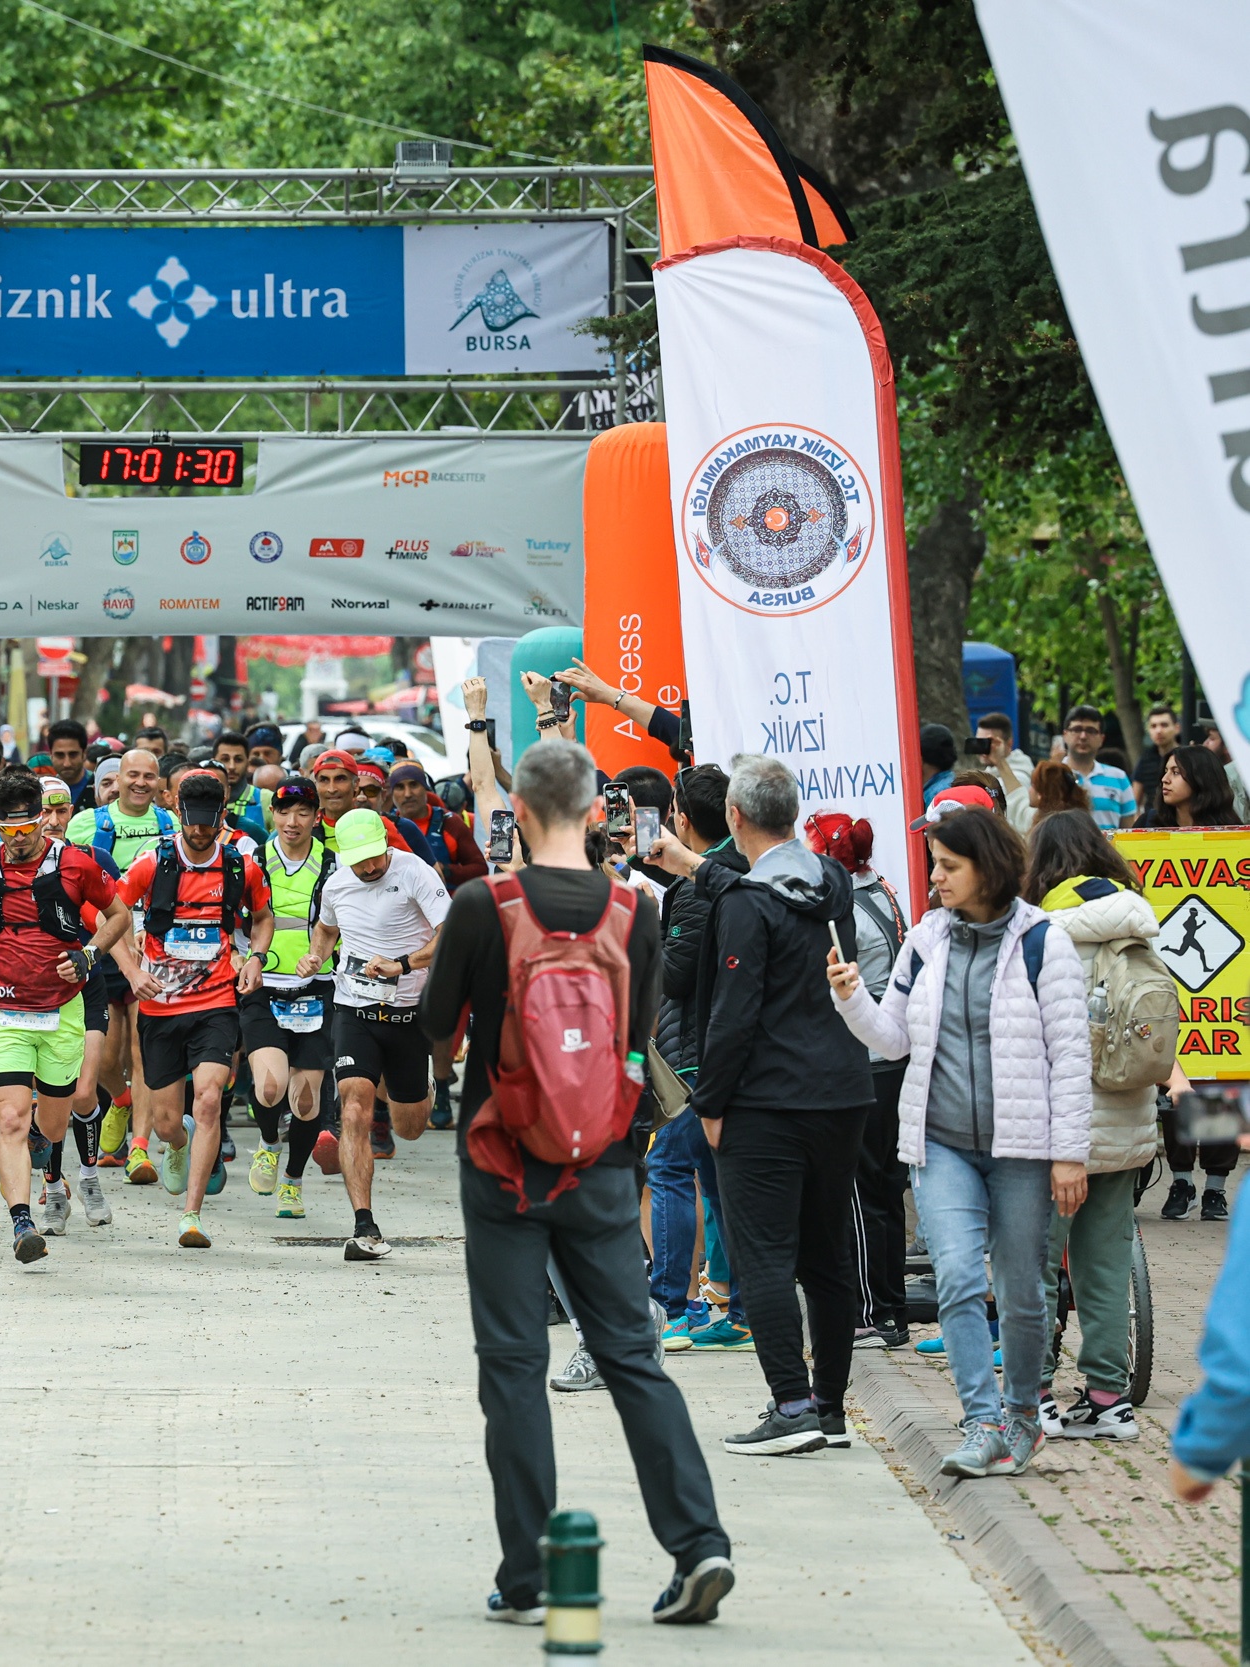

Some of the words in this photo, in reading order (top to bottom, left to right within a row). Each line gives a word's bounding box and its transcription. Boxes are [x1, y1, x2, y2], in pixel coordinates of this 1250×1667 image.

[231, 273, 349, 319] ultra
[466, 334, 531, 352] BURSA
[100, 447, 237, 485] 17:01:30
[382, 469, 429, 488] MCR
[394, 540, 430, 552] PLUS
[525, 538, 571, 553] Turkey
[37, 599, 79, 611] Neskar
[103, 598, 135, 609] HAYAT
[159, 598, 221, 610] ROMATEM
[614, 613, 642, 741] Acess
[188, 927, 207, 940] 16
[290, 1002, 309, 1014] 25
[1179, 997, 1250, 1026] RIŞ
[1178, 1029, 1242, 1056] AR
